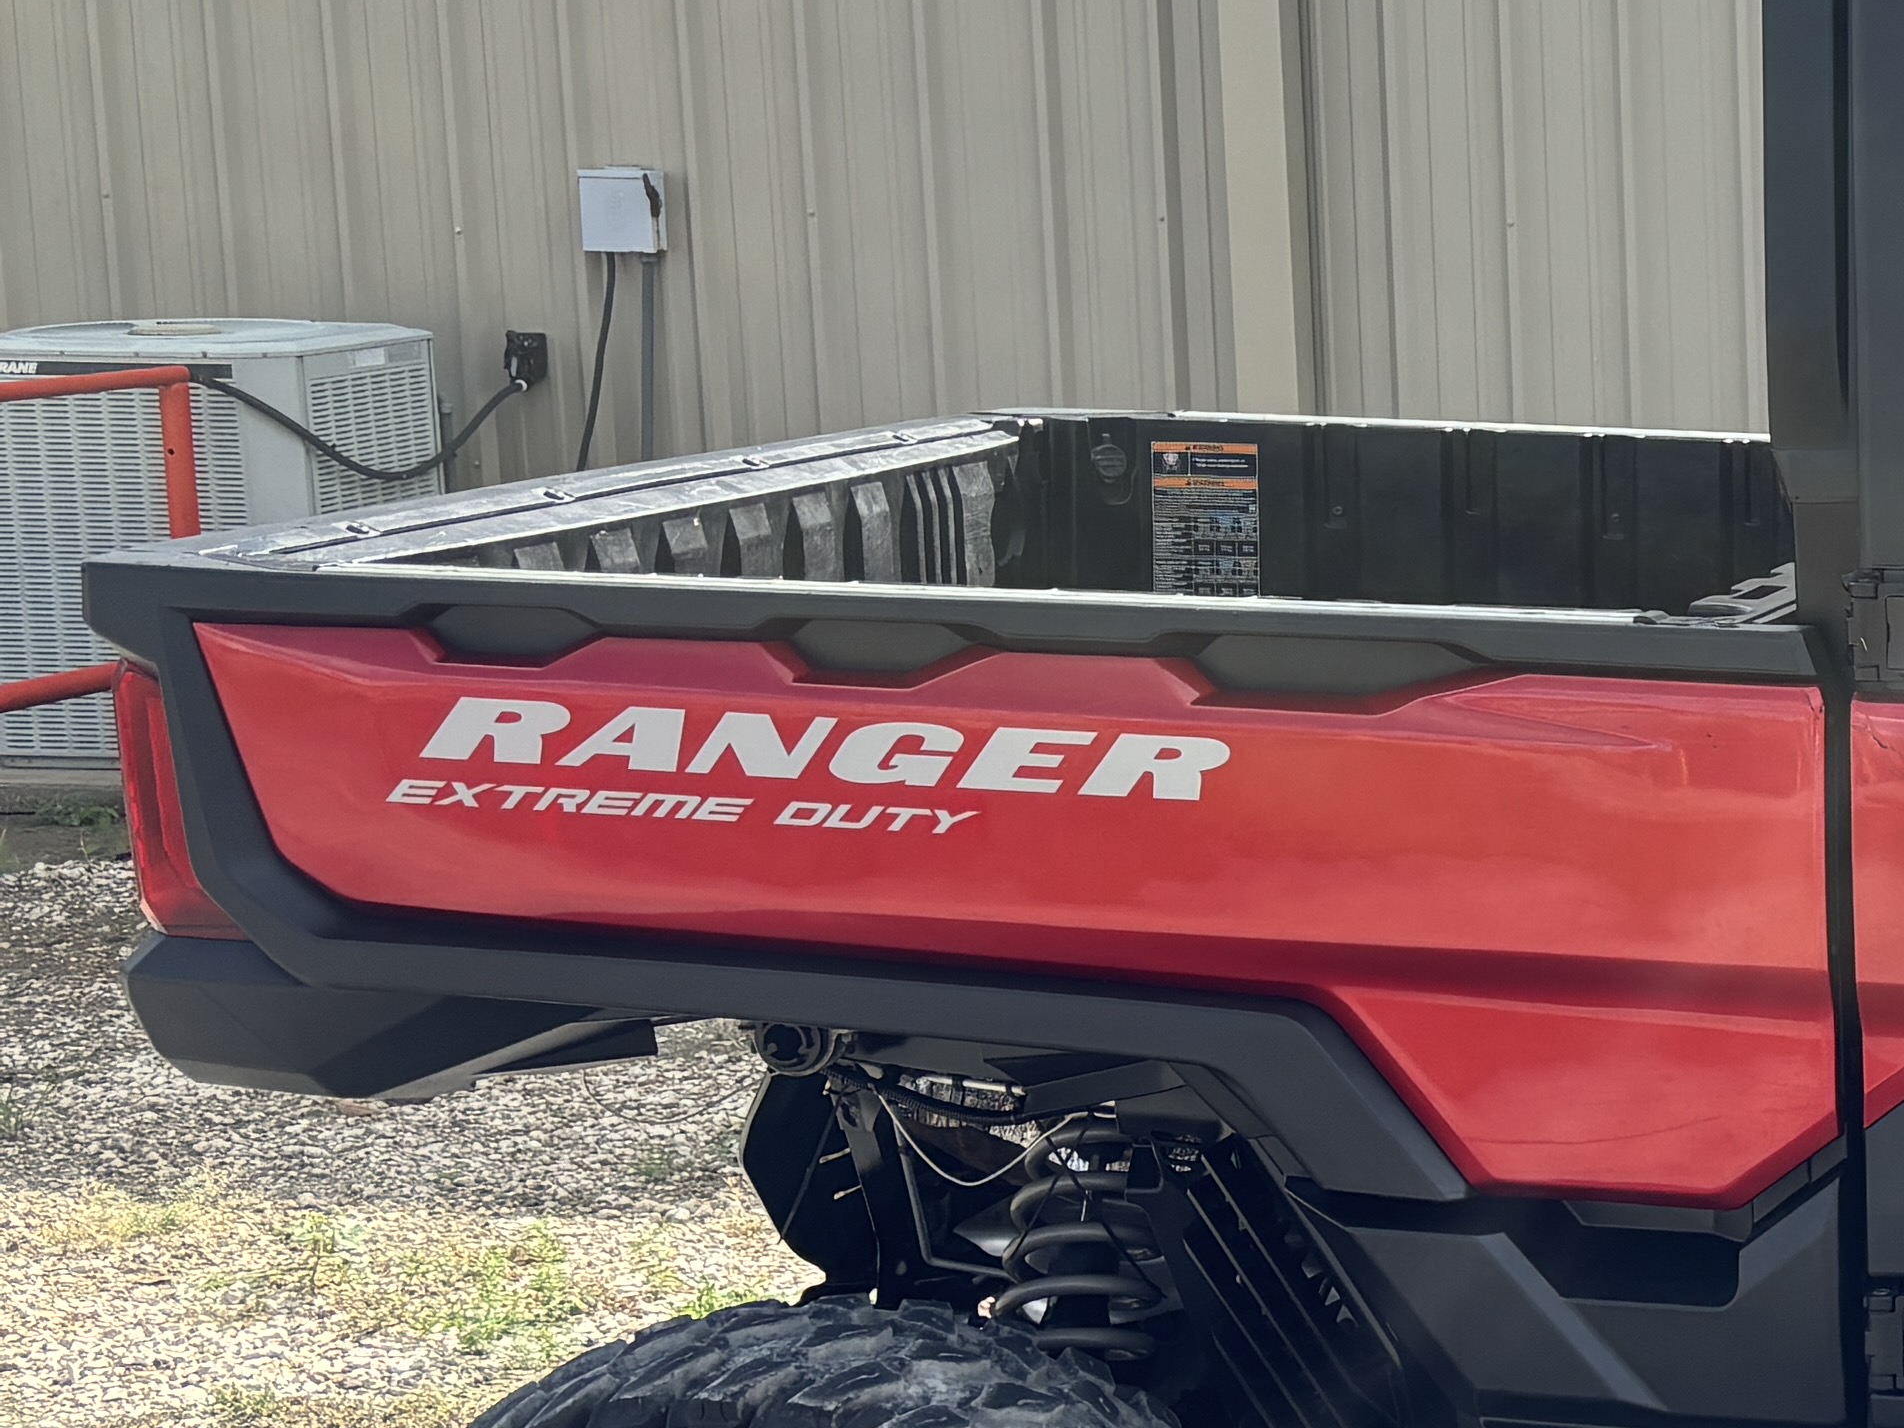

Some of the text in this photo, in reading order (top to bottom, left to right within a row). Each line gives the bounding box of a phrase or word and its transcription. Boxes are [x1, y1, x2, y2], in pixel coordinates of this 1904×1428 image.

[0, 361, 38, 374] RANE
[419, 696, 1231, 801] RANGER
[386, 779, 982, 835] EXTREME DUTY
